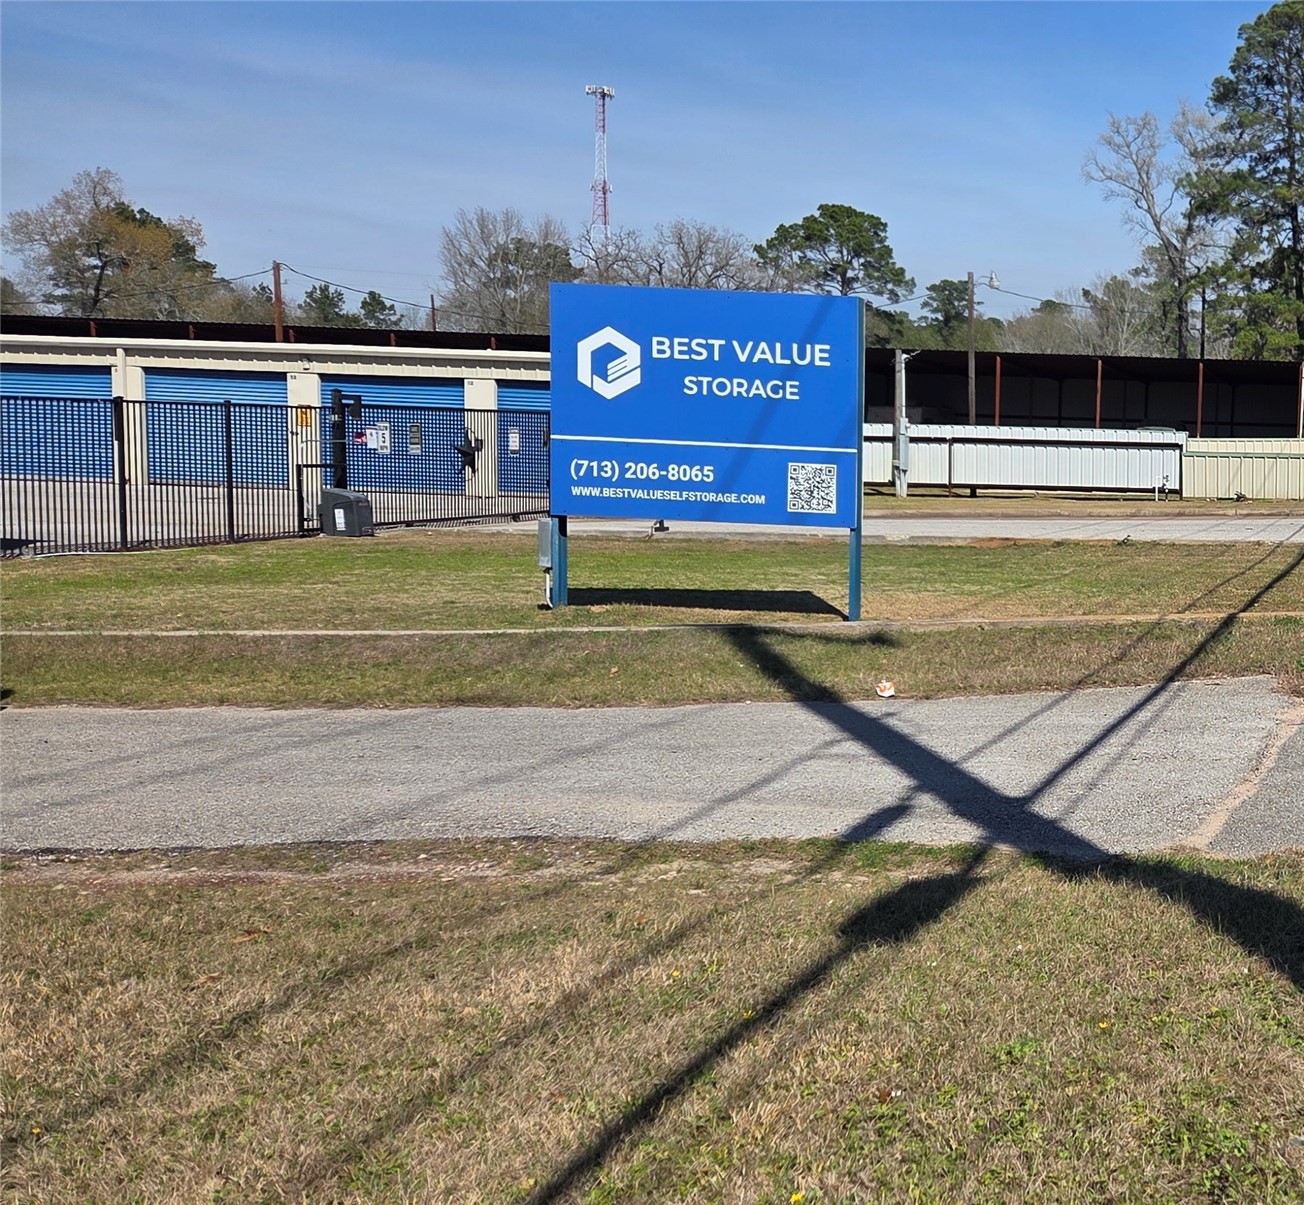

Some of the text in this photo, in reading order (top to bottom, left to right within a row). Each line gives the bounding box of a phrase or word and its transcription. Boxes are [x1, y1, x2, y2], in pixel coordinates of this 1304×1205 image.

[652, 336, 831, 366] BEST VALUE
[683, 376, 800, 400] STORAGE
[381, 432, 386, 444] 5
[570, 458, 714, 482] (713) 206-8065
[571, 485, 766, 504] WWW.BESTVALUESELFSTORAGE.COM
